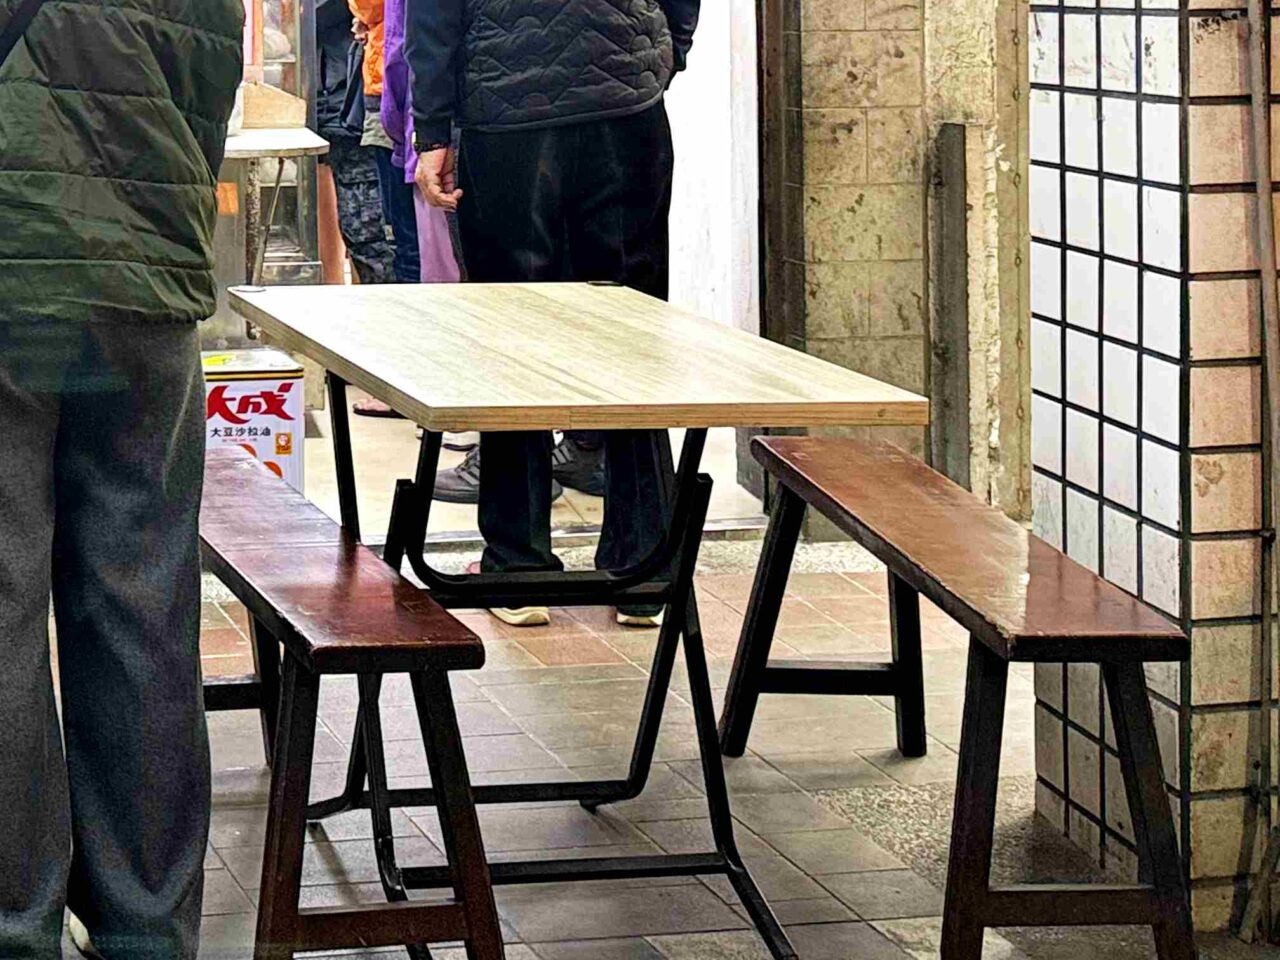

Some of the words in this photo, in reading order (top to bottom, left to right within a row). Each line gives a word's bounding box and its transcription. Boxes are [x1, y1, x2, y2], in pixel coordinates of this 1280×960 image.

[206, 382, 296, 425] 大成
[210, 426, 272, 438] 大豆沙拉油
